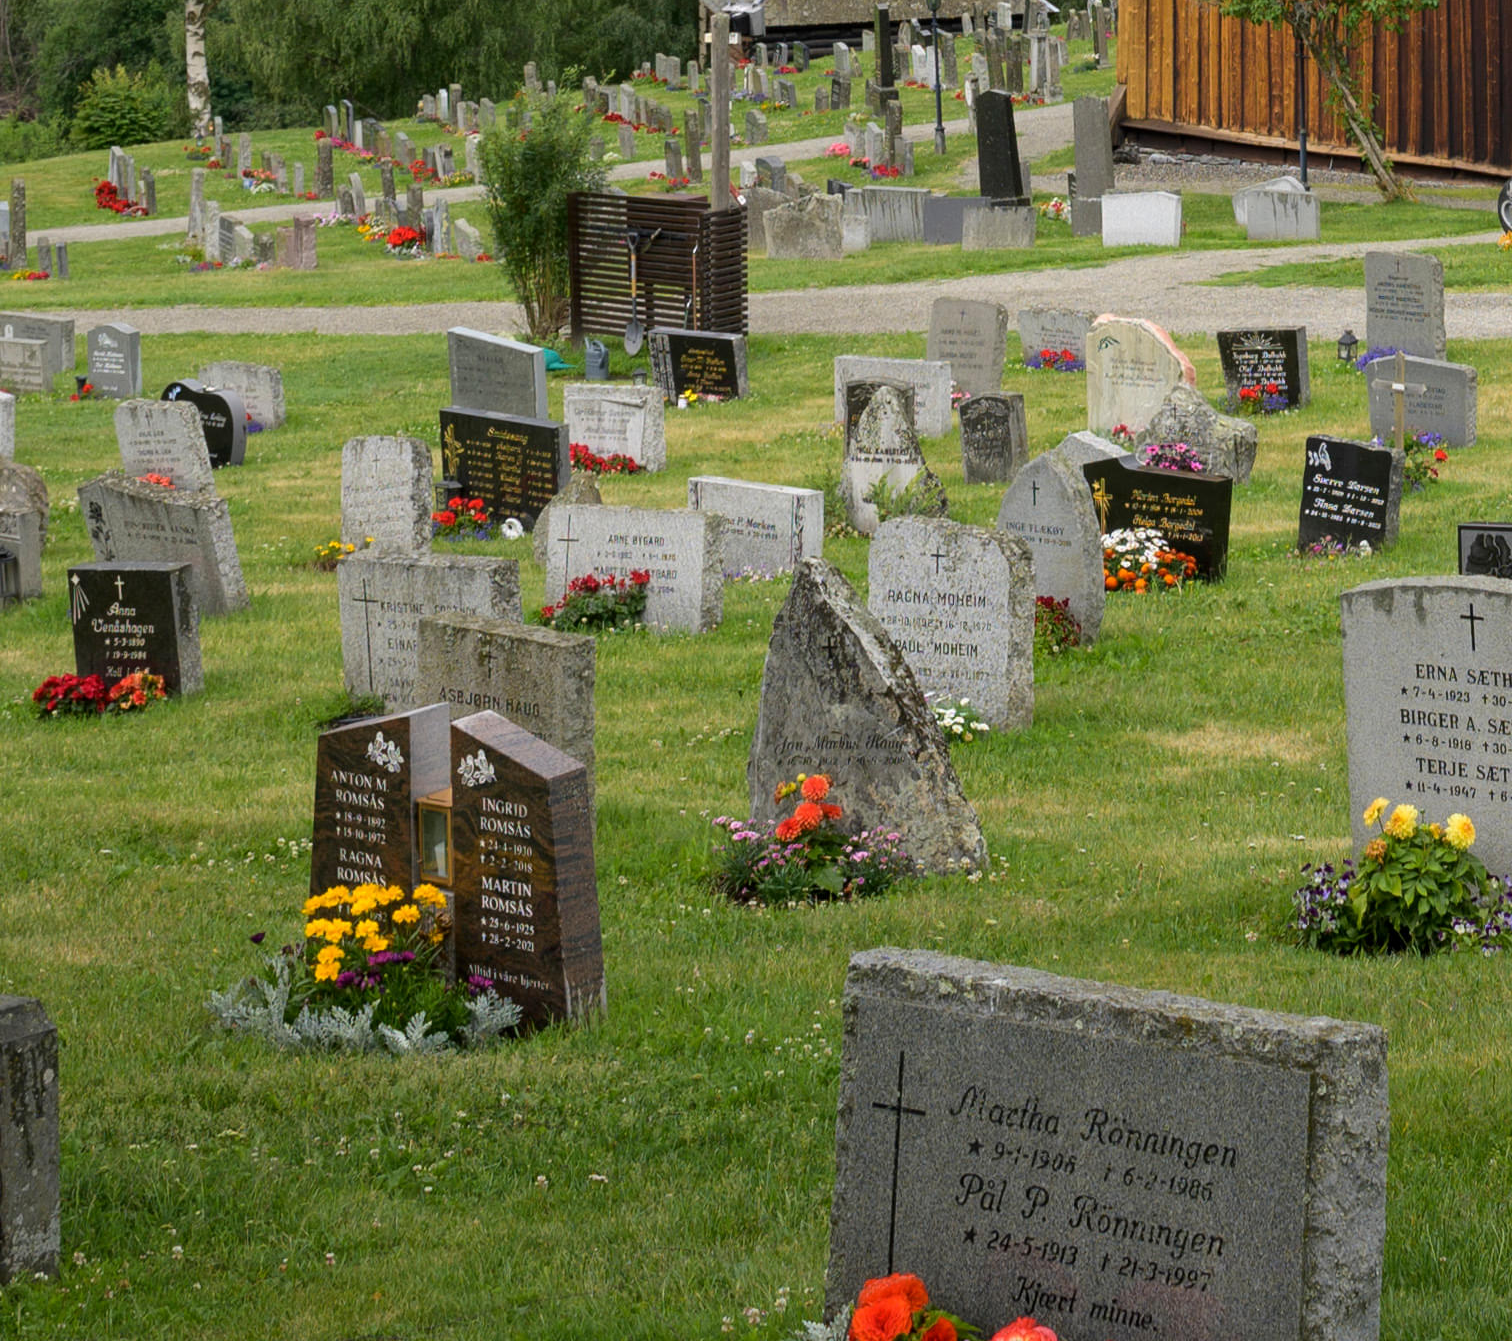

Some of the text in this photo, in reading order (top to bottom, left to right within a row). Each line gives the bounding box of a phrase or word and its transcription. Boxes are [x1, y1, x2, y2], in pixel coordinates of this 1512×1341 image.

[888, 589, 986, 608] RAGNA MOHEIM
[106, 602, 137, 618] Anna
[91, 618, 156, 637] Venåshagen
[934, 643, 978, 658] MOHEIM
[1415, 664, 1458, 683] ERNA
[438, 687, 501, 710] ASBJØRN
[506, 697, 540, 720] HAUG
[1412, 686, 1471, 704] 7-4-1923
[1400, 708, 1459, 730] BIRGER
[1466, 716, 1481, 733] A.
[1415, 757, 1469, 779] TERJE
[330, 770, 390, 793] ANTON M.
[1417, 780, 1477, 799] 11-4-1947
[336, 789, 386, 812] ROMSÅS
[481, 797, 529, 819] INGRID
[480, 816, 533, 839] ROMSÅS
[339, 848, 383, 869] RAGNA
[337, 867, 387, 888] ROMSÅS
[481, 875, 533, 898] MARTIN
[481, 895, 534, 919] ROMSÅS
[948, 1085, 1239, 1170] Martha Rönningen
[955, 1172, 1224, 1259] Pål P. Rönningen
[987, 1229, 1079, 1266] 24-5-1913
[1011, 1275, 1077, 1317] Kjært
